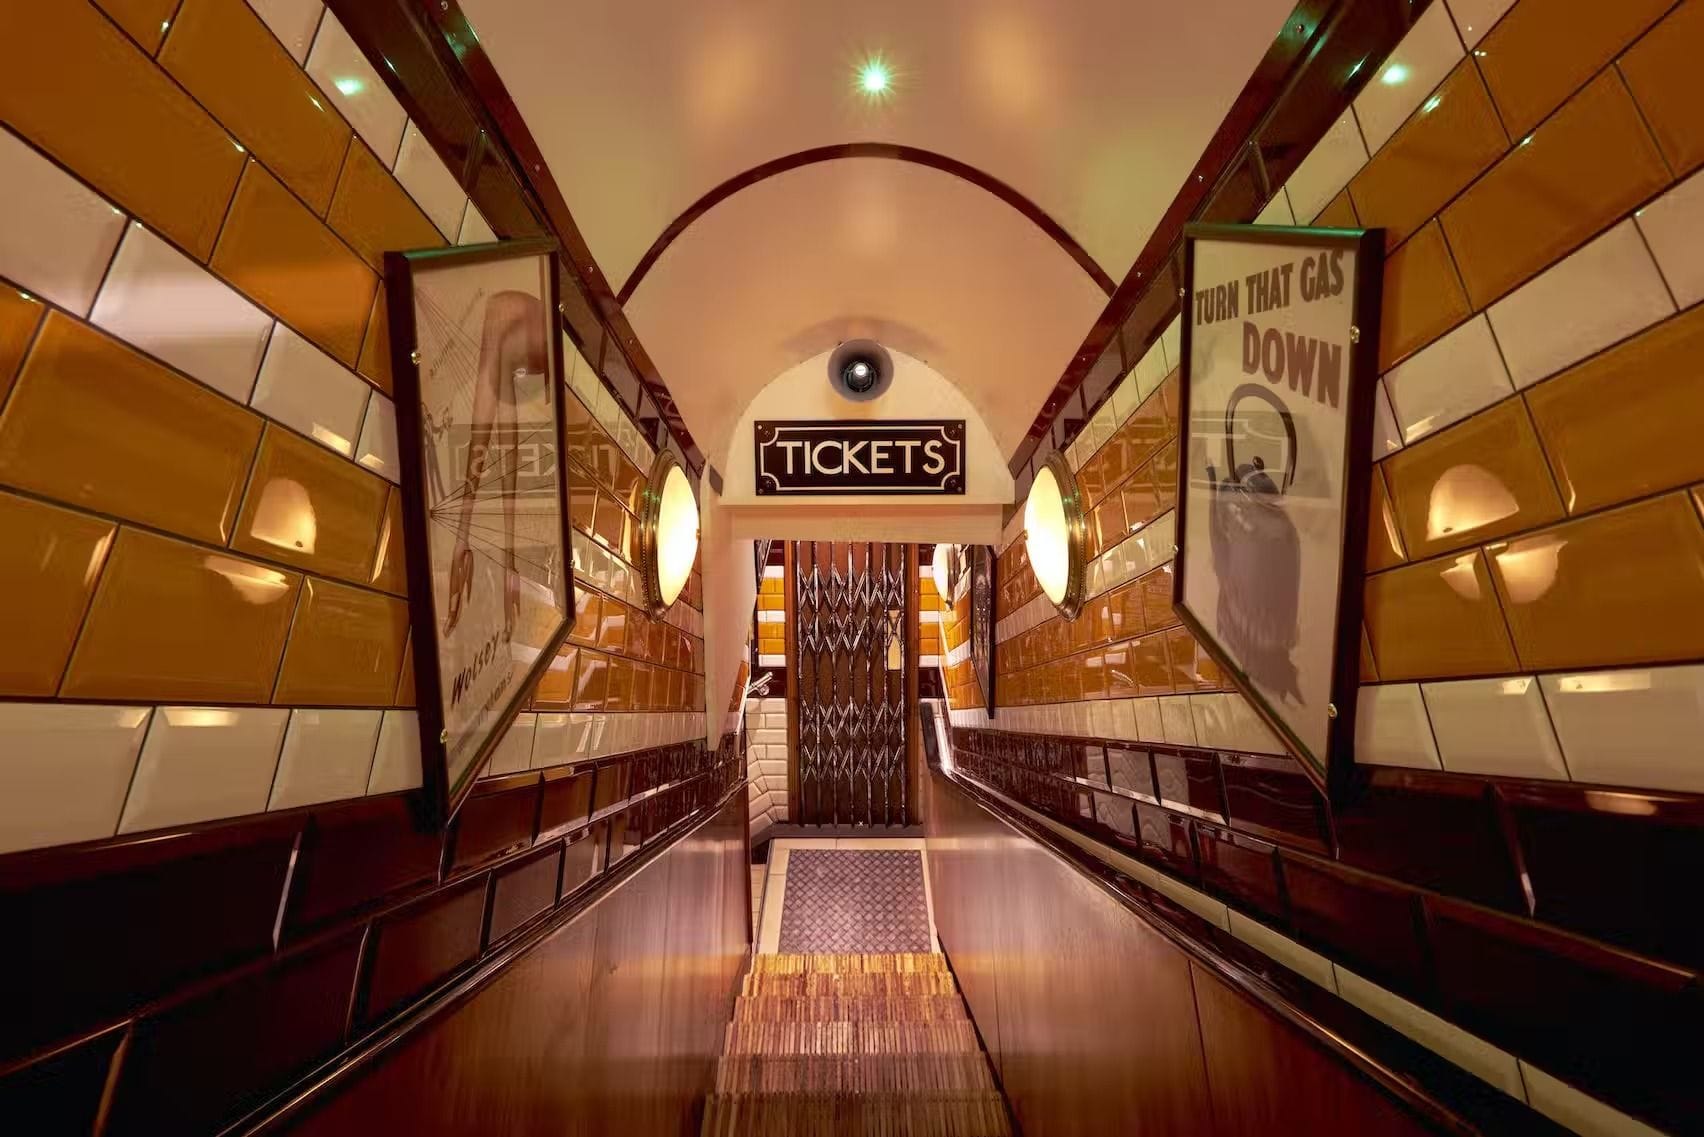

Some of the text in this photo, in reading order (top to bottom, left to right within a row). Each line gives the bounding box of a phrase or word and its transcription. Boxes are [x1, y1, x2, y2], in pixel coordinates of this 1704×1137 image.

[1196, 250, 1344, 325] TURN THAT GAS
[1242, 320, 1342, 409] DOWN
[775, 440, 945, 475] TICKETS
[451, 631, 499, 709] Wolsey
